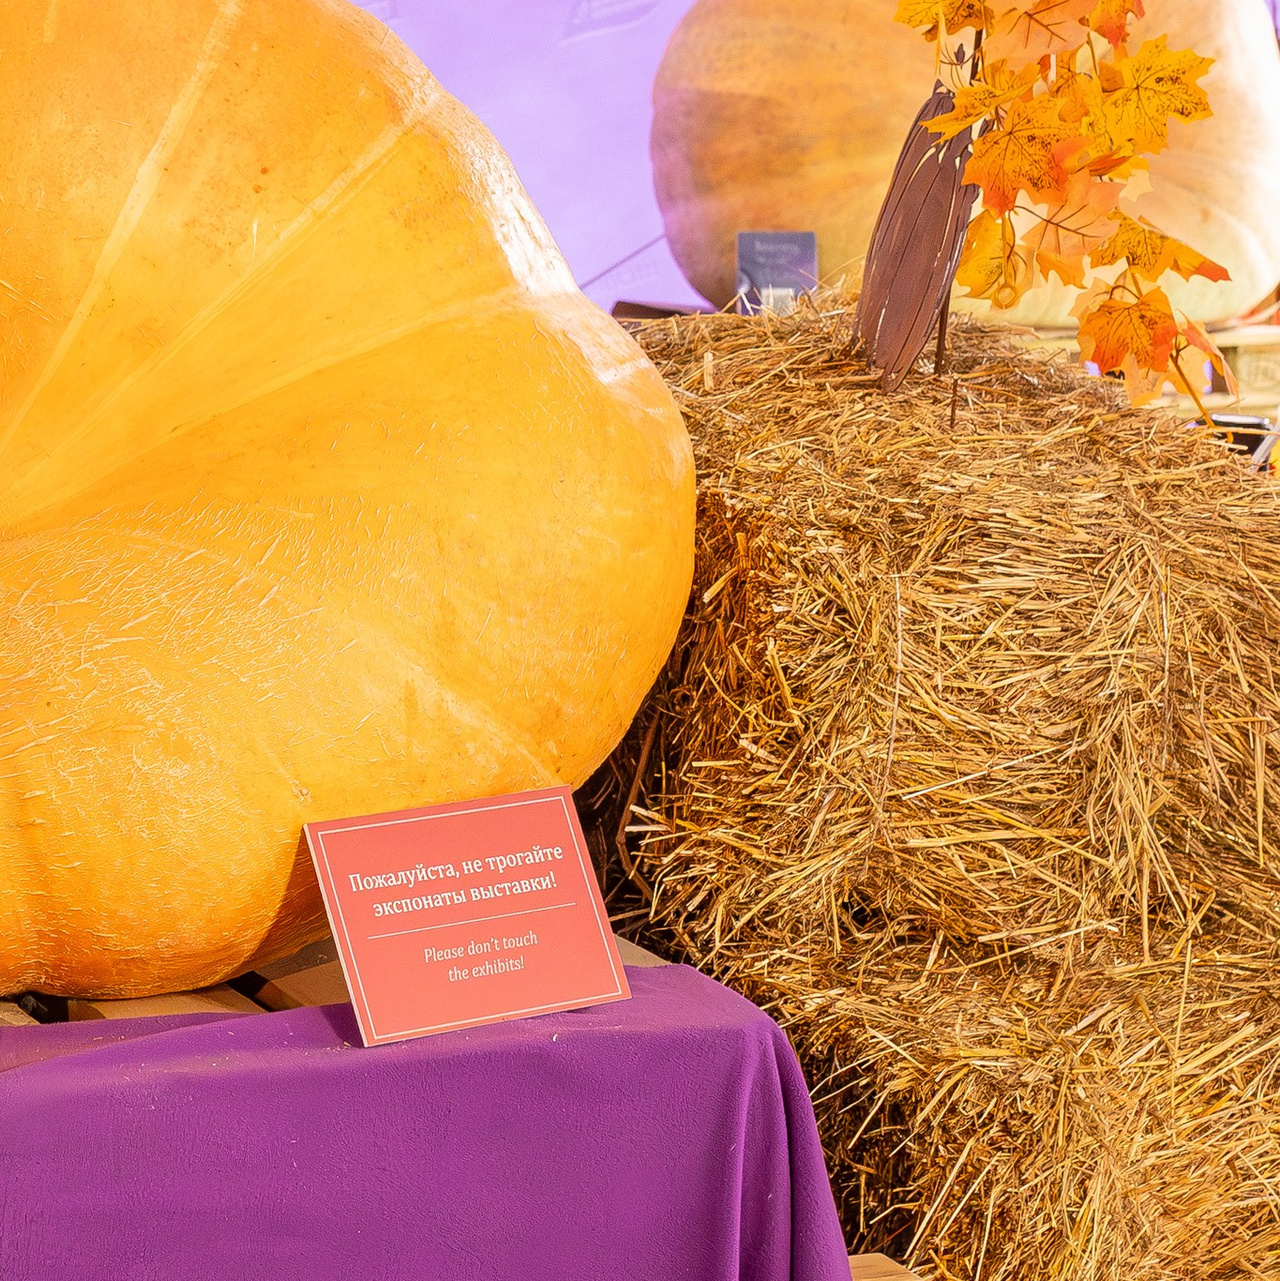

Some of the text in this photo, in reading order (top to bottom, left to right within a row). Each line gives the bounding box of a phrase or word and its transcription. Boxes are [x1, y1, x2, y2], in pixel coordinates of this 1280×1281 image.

[348, 845, 564, 892] Пожалуйста, не трогайте
[372, 870, 558, 917] экспонаты выставки!
[424, 946, 465, 963] Please
[502, 930, 539, 950] touch
[448, 955, 525, 982] the exhibits!
